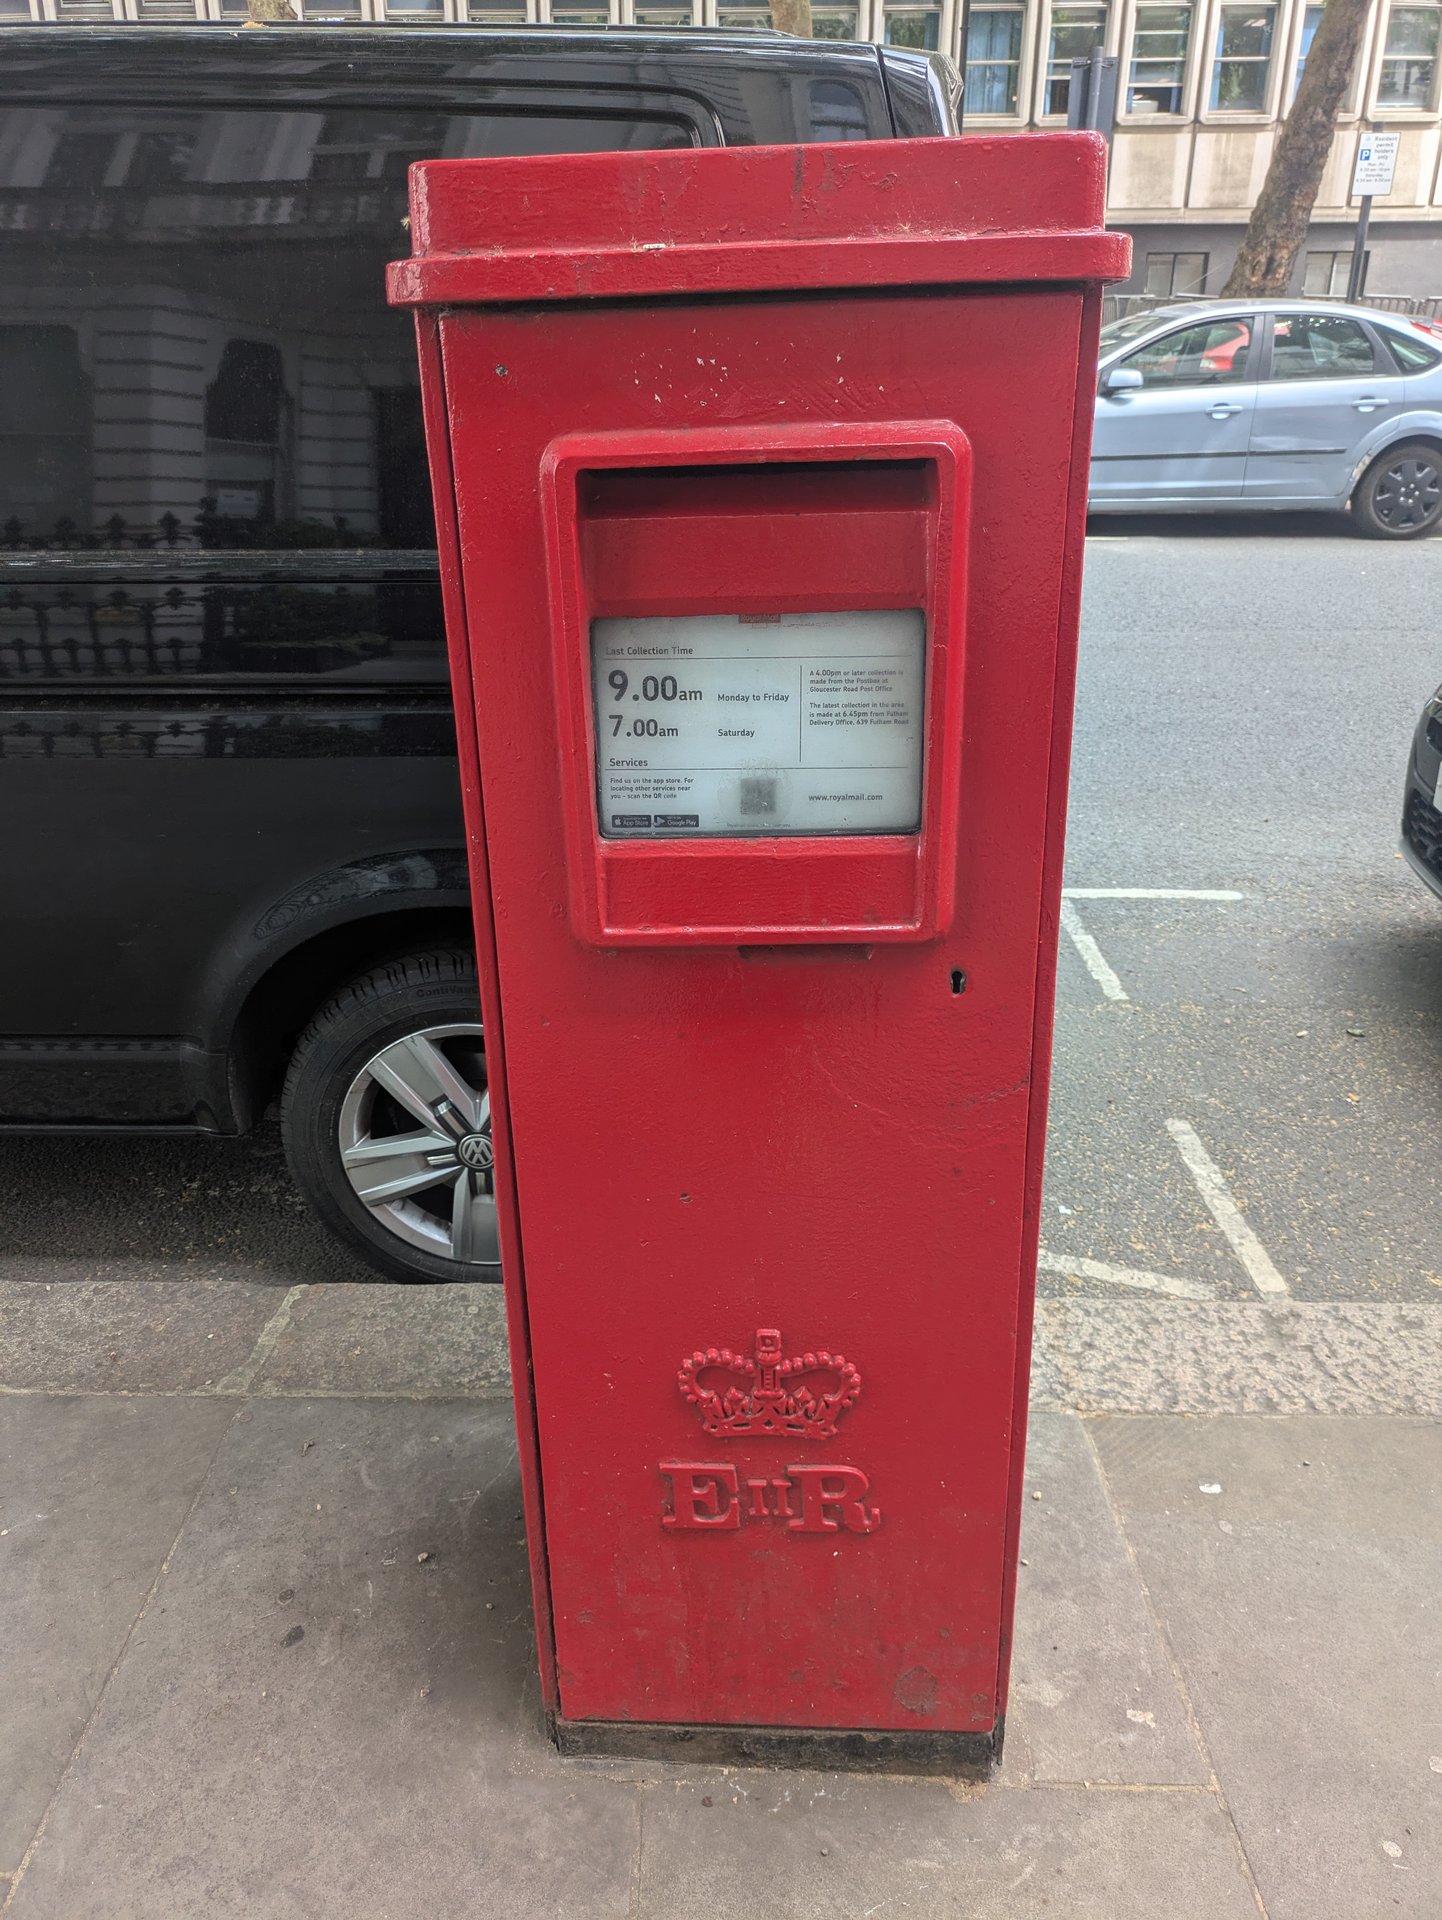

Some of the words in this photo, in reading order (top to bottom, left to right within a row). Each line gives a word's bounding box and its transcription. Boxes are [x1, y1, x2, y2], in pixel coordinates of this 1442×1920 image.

[1361, 150, 1370, 160] P
[606, 647, 624, 655] Last
[627, 646, 669, 655] Collection
[672, 646, 693, 655] Time
[815, 669, 841, 677] 4.00pm
[608, 669, 703, 701] 9.00am
[717, 693, 750, 703] Monday
[763, 693, 790, 703] Friday
[842, 711, 869, 719] 6.45pm
[608, 714, 679, 738] 7.00am
[717, 728, 755, 738] Saturday
[609, 758, 649, 767] Services
[808, 793, 883, 802] www.royalmail.com
